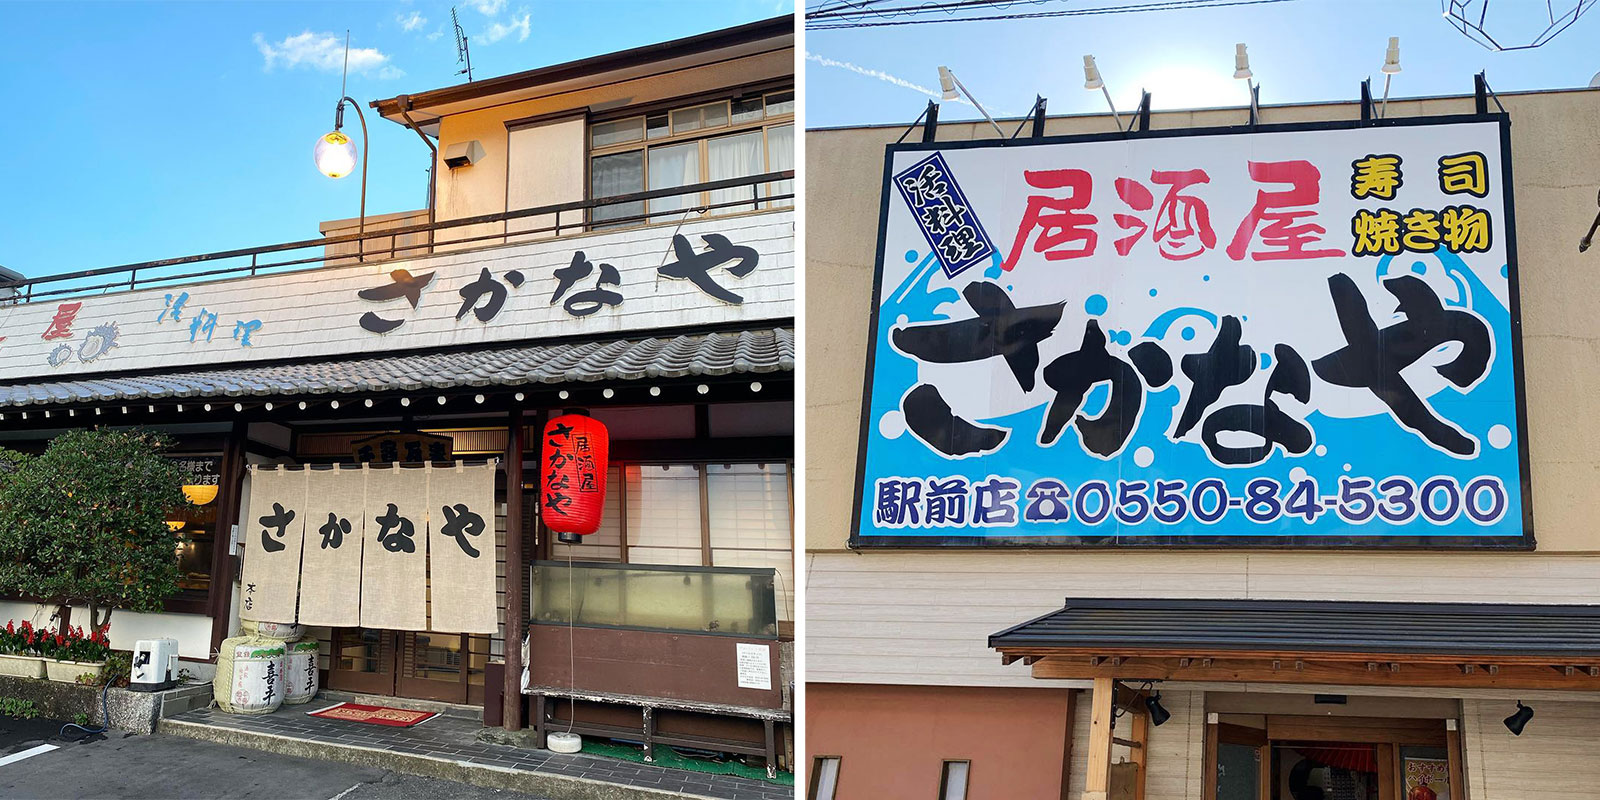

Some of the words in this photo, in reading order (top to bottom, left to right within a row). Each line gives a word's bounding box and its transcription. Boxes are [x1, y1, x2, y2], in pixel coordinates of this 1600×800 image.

[903, 164, 984, 264] 活料理
[1000, 160, 1347, 272] 居酒屋
[1351, 207, 1492, 257] 焼き物
[357, 233, 760, 334] さかなや
[890, 271, 1494, 466] さかなや
[545, 423, 574, 516] さかなや
[575, 436, 596, 490] 居酒屋
[257, 502, 487, 559] さかなや
[875, 479, 1020, 526] 駅前店
[1075, 477, 1508, 524] 0550-84-5300
[261, 660, 279, 706] 喜平
